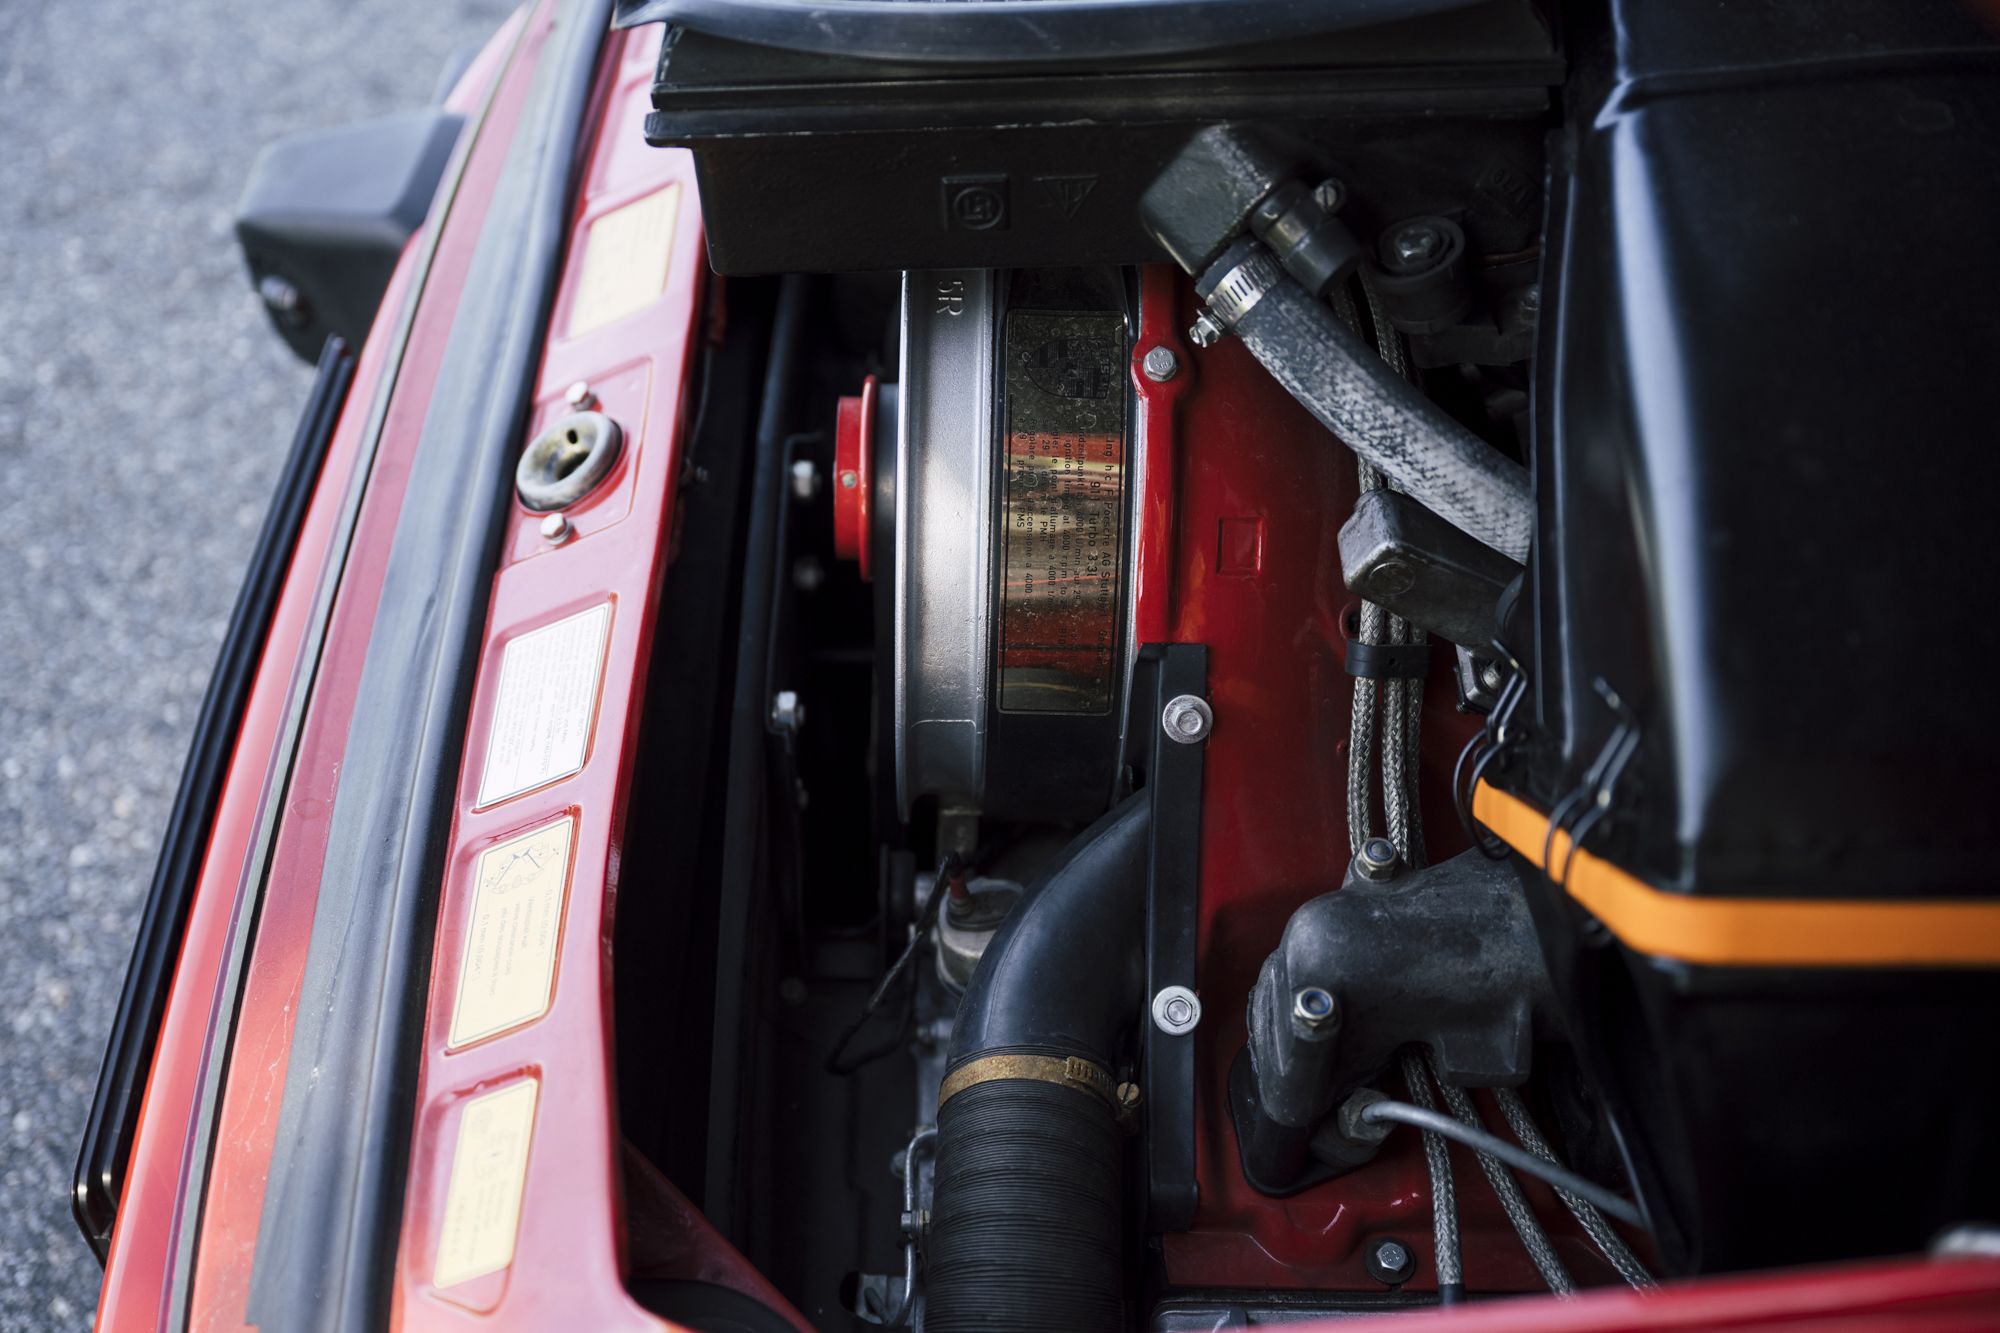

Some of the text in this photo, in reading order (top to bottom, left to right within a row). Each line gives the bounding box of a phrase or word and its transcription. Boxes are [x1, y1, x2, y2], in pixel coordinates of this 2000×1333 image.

[1090, 481, 1101, 501] 911
[1016, 507, 1026, 528] PMS
[1102, 502, 1113, 547] Porsche
[1039, 521, 1048, 542] PMH
[1088, 511, 1100, 547] Turbo
[1061, 529, 1070, 551] 4000
[1101, 551, 1112, 567] AG
[1024, 572, 1033, 594] 4000
[1047, 565, 1057, 586] 4000
